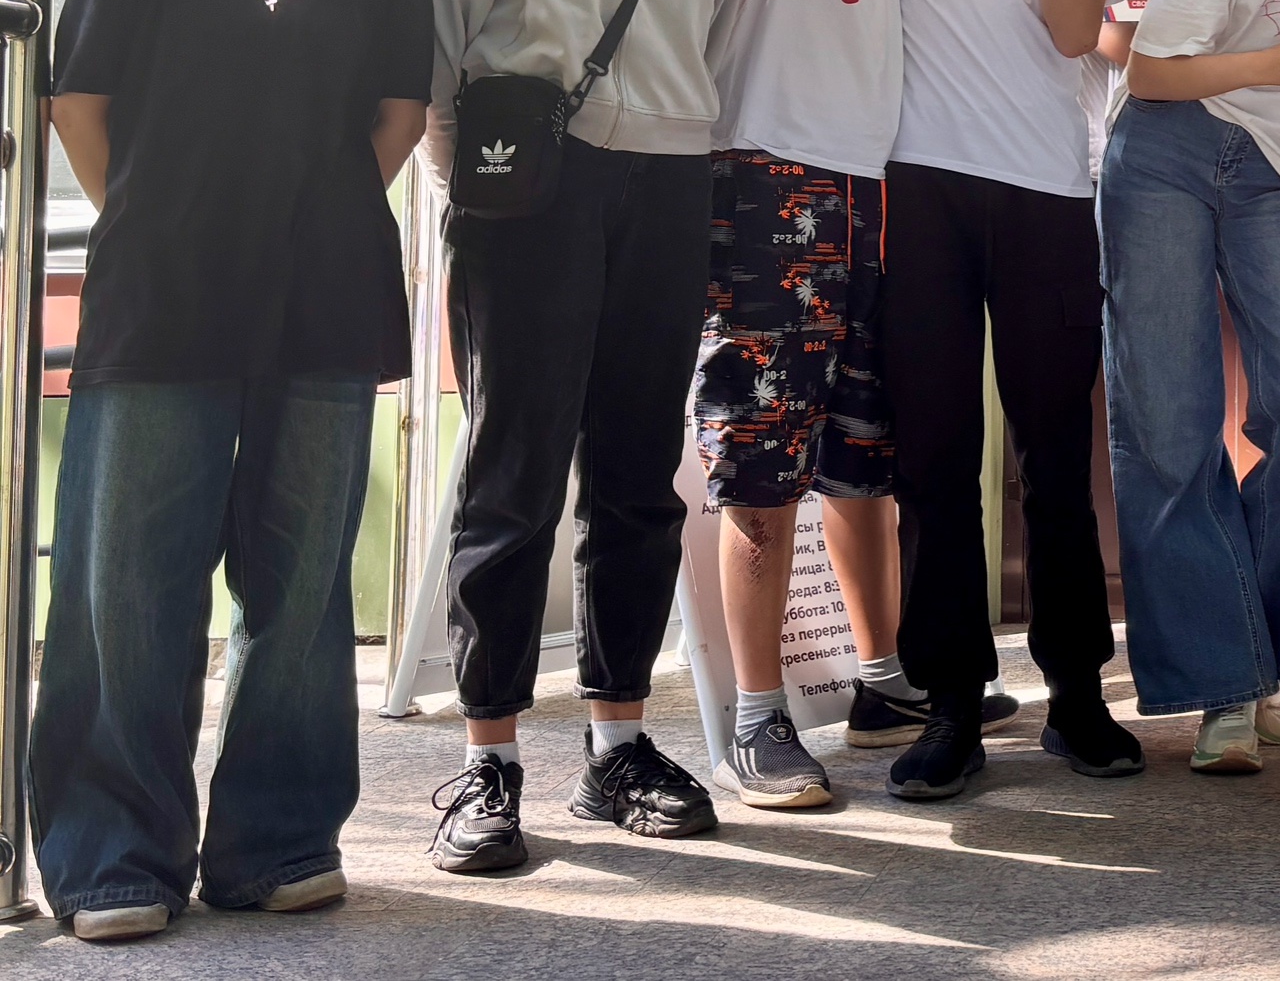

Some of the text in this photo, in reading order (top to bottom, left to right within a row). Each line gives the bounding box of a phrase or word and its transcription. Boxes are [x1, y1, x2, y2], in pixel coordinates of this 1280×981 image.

[476, 164, 513, 174] adidas
[791, 562, 826, 577] ница:
[788, 585, 822, 601] реда:
[783, 605, 830, 624] уббота:
[781, 623, 852, 644] ез перерыв
[780, 646, 841, 668] кресенье:
